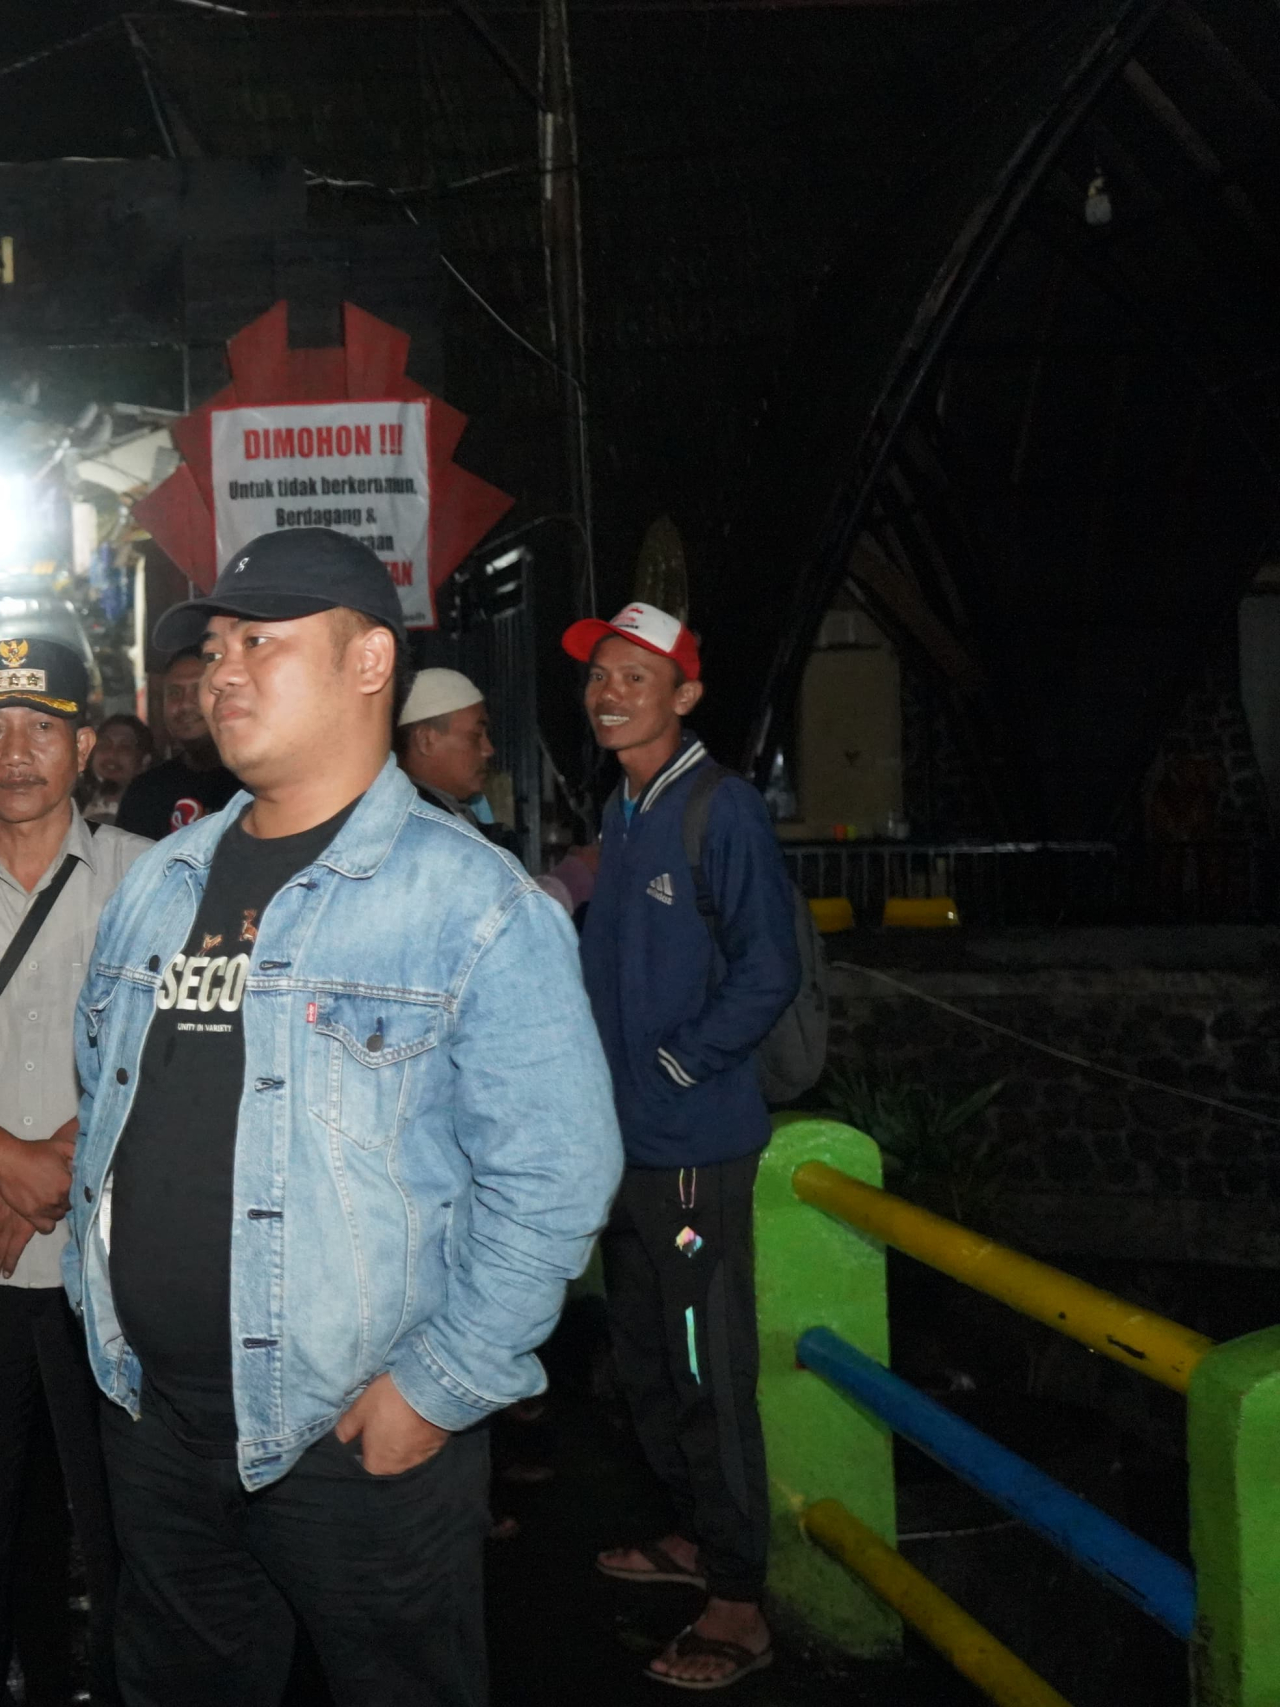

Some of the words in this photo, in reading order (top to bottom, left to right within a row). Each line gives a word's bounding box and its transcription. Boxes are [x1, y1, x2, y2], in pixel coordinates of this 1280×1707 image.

[244, 424, 372, 460] DIMOHON
[380, 424, 403, 455] !!!
[229, 480, 274, 500] Untuk
[278, 478, 318, 497] tidak
[276, 507, 362, 527] Berdagang
[366, 506, 377, 523] &
[177, 1022, 195, 1032] UNITY
[205, 1023, 233, 1033] VARIETY
